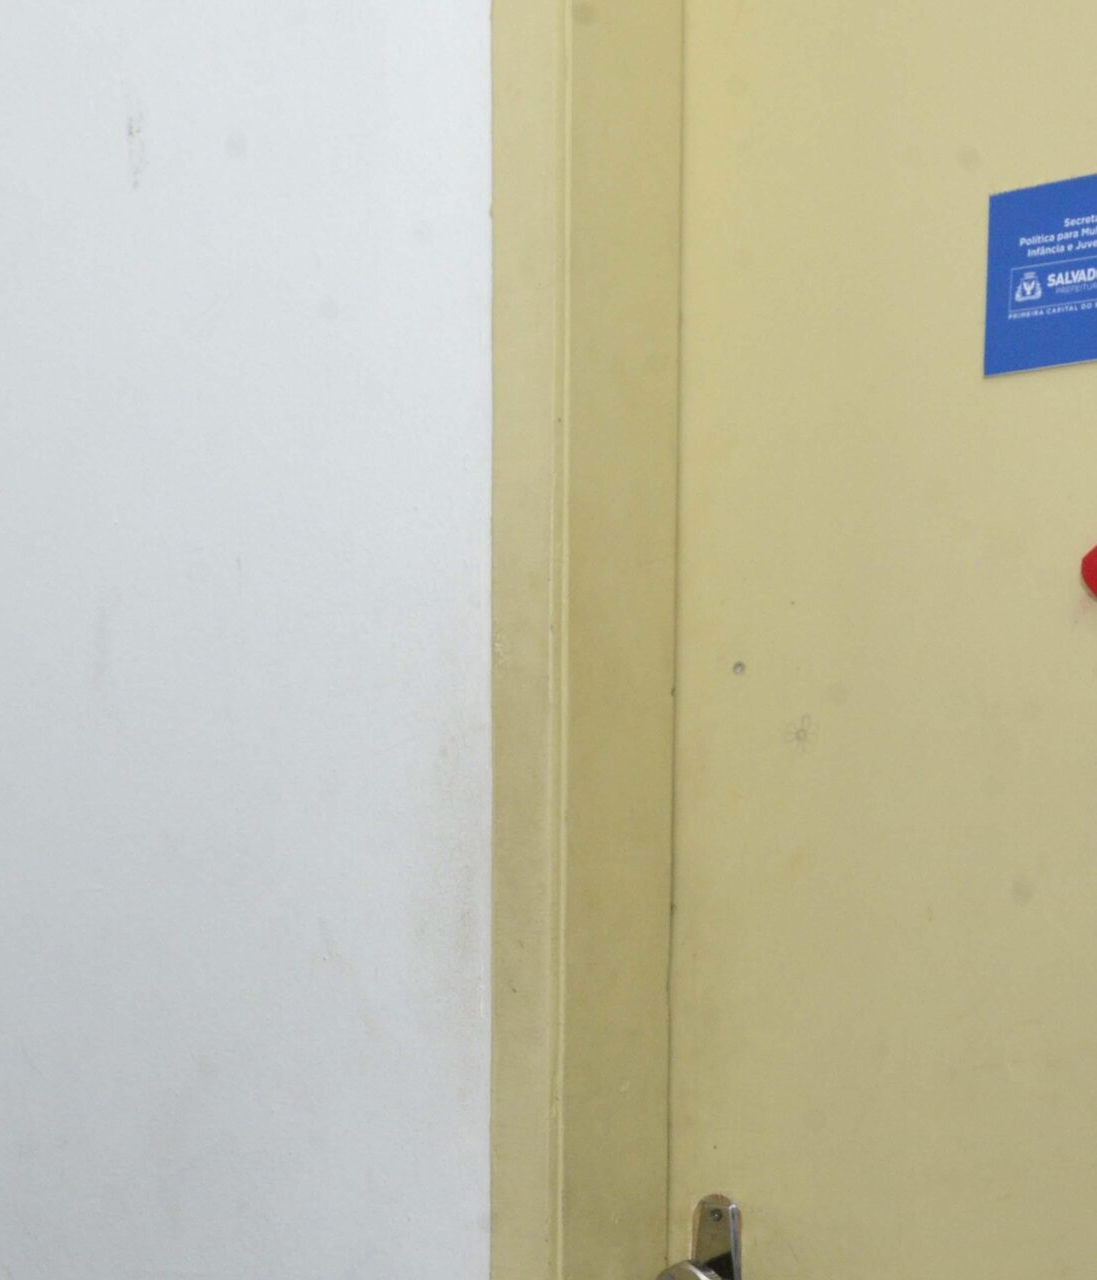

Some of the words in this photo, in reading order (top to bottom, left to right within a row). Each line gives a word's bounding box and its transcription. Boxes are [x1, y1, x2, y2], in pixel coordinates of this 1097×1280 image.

[1063, 214, 1097, 228] Secret
[1056, 230, 1079, 242] para
[1066, 243, 1074, 252] e
[1046, 304, 1078, 316] CAPITAL
[1080, 302, 1093, 311] DO
